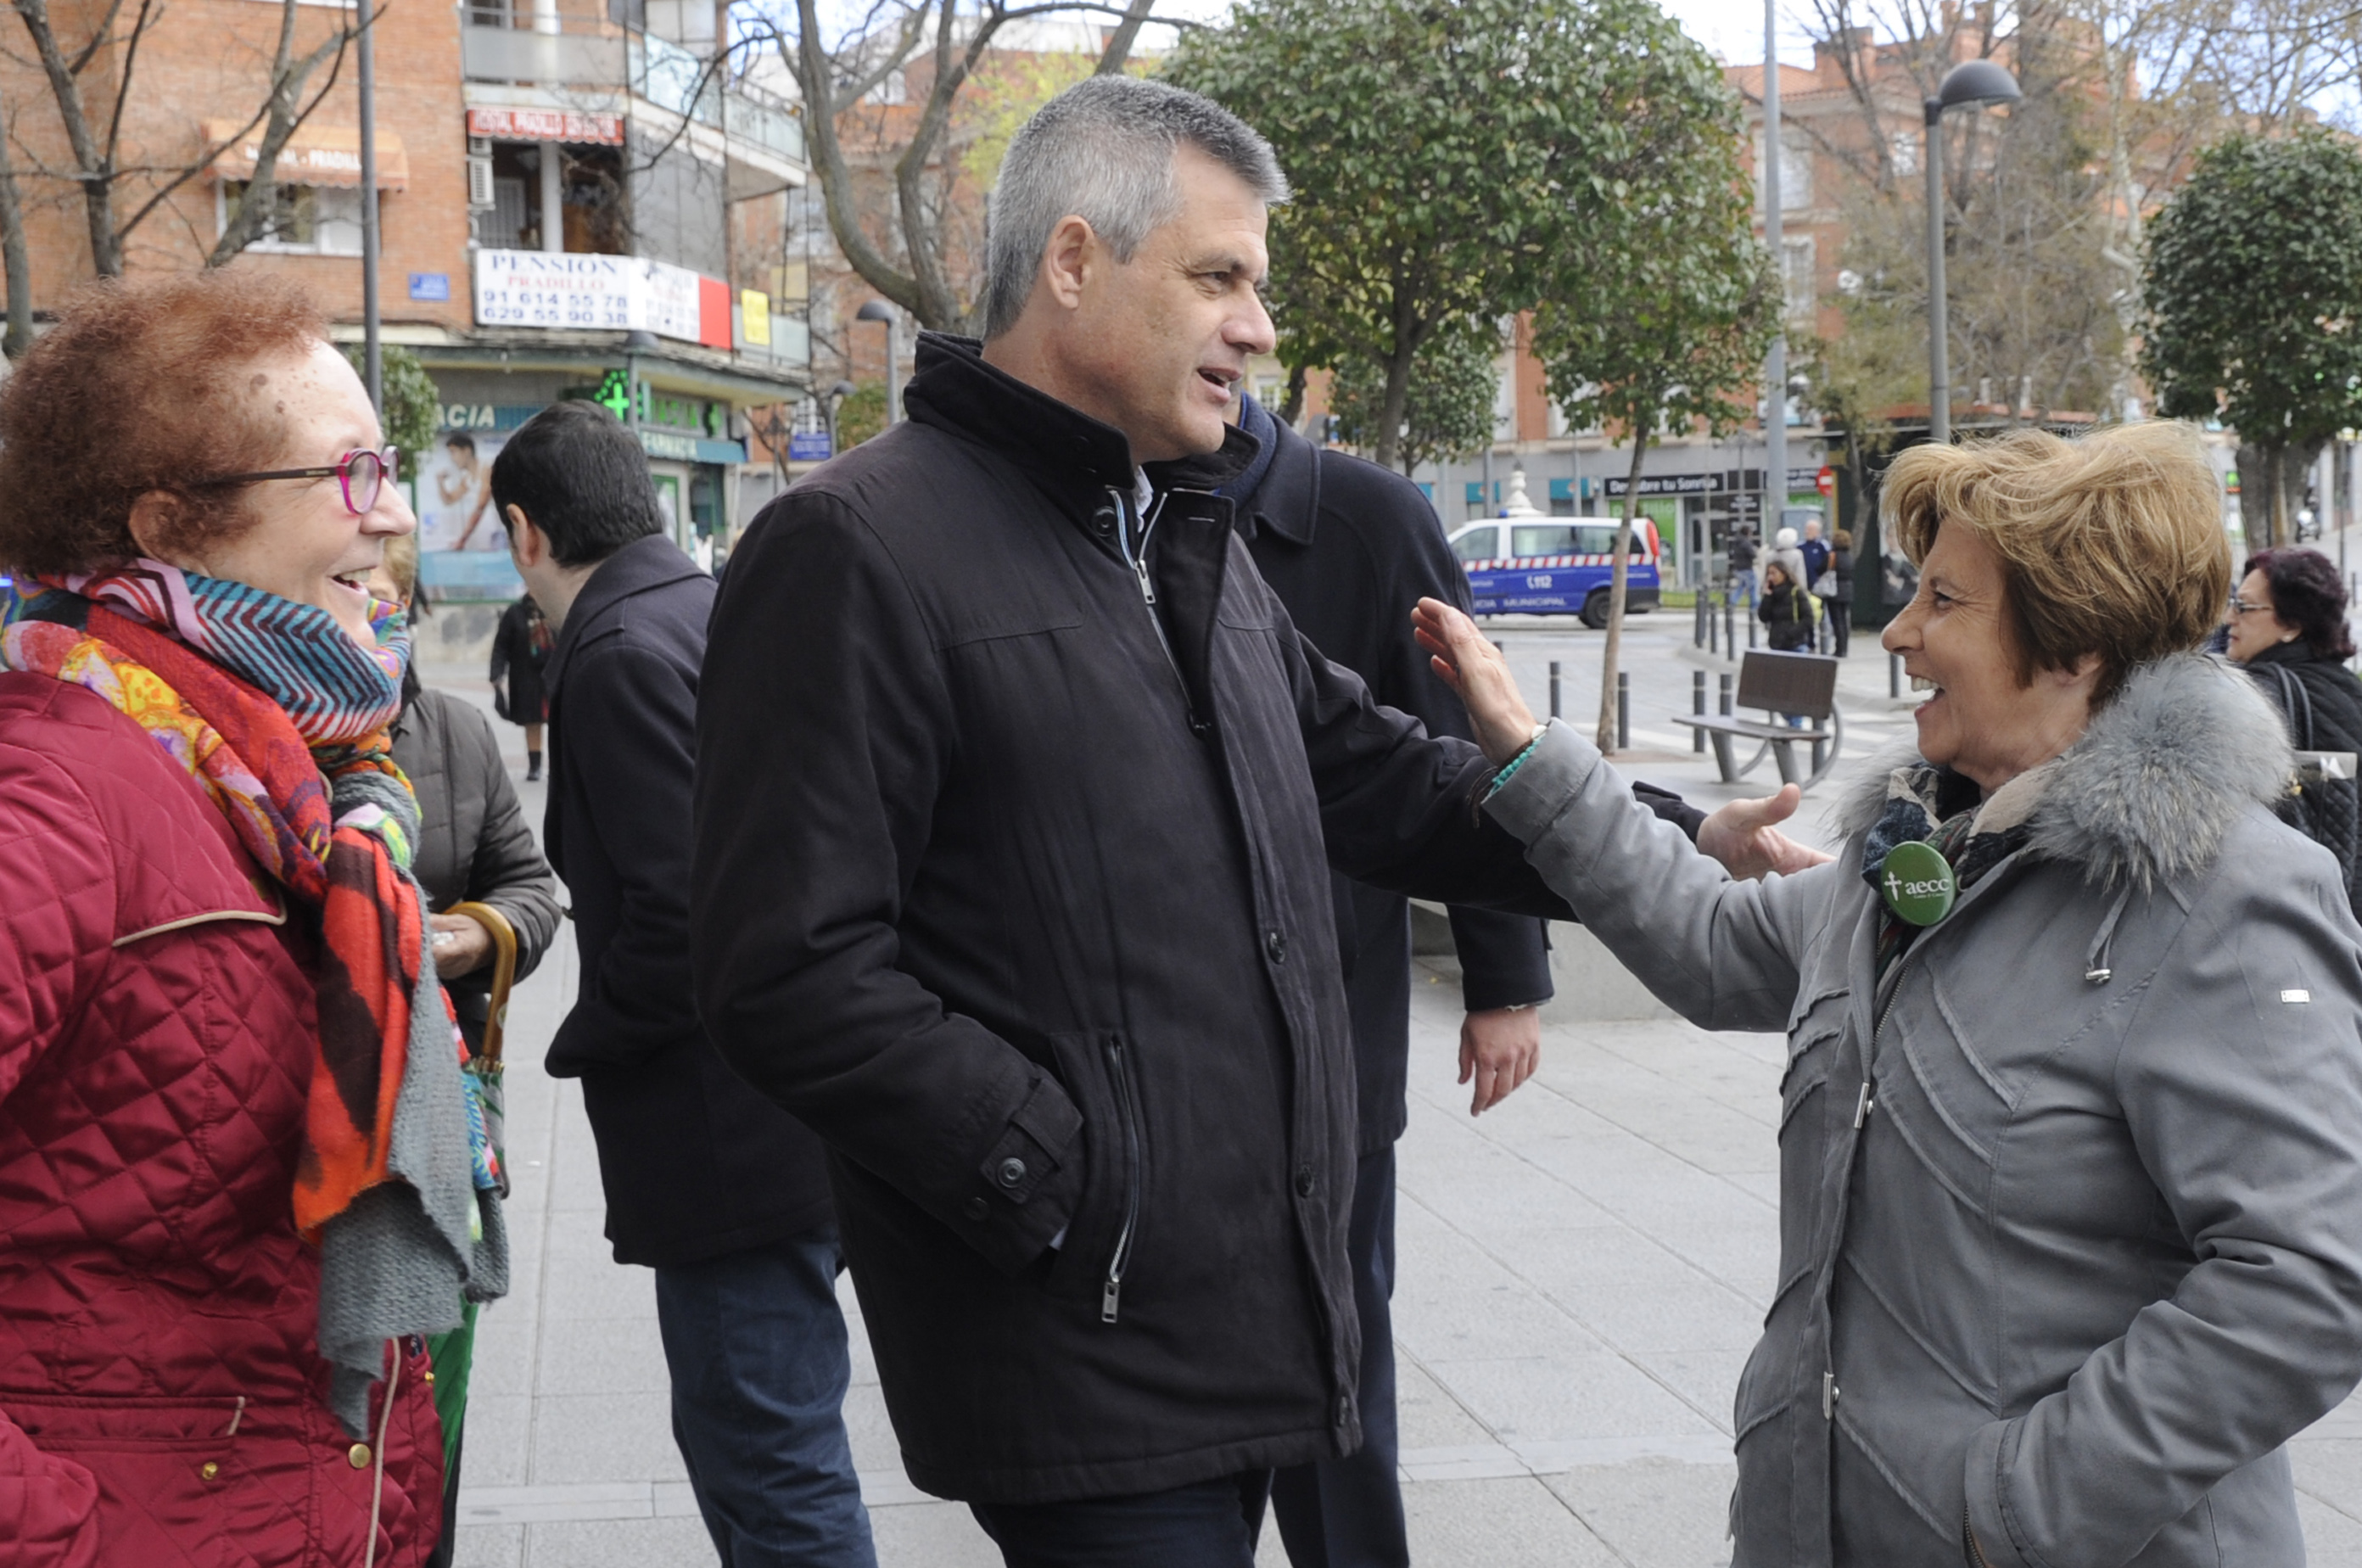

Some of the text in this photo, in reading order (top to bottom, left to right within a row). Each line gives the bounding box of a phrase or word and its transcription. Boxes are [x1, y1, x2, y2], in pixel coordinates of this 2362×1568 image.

[491, 255, 617, 274] PENSION
[507, 276, 605, 291] PRADILLO
[484, 290, 628, 309] 91 614 55 78
[484, 307, 524, 320] 629
[534, 309, 560, 322] 55
[568, 311, 594, 322] 90
[1662, 479, 1676, 491] tu
[1534, 574, 1553, 589] 112
[1503, 596, 1566, 608] MUNICIPAL
[1905, 878, 1950, 894] aecc
